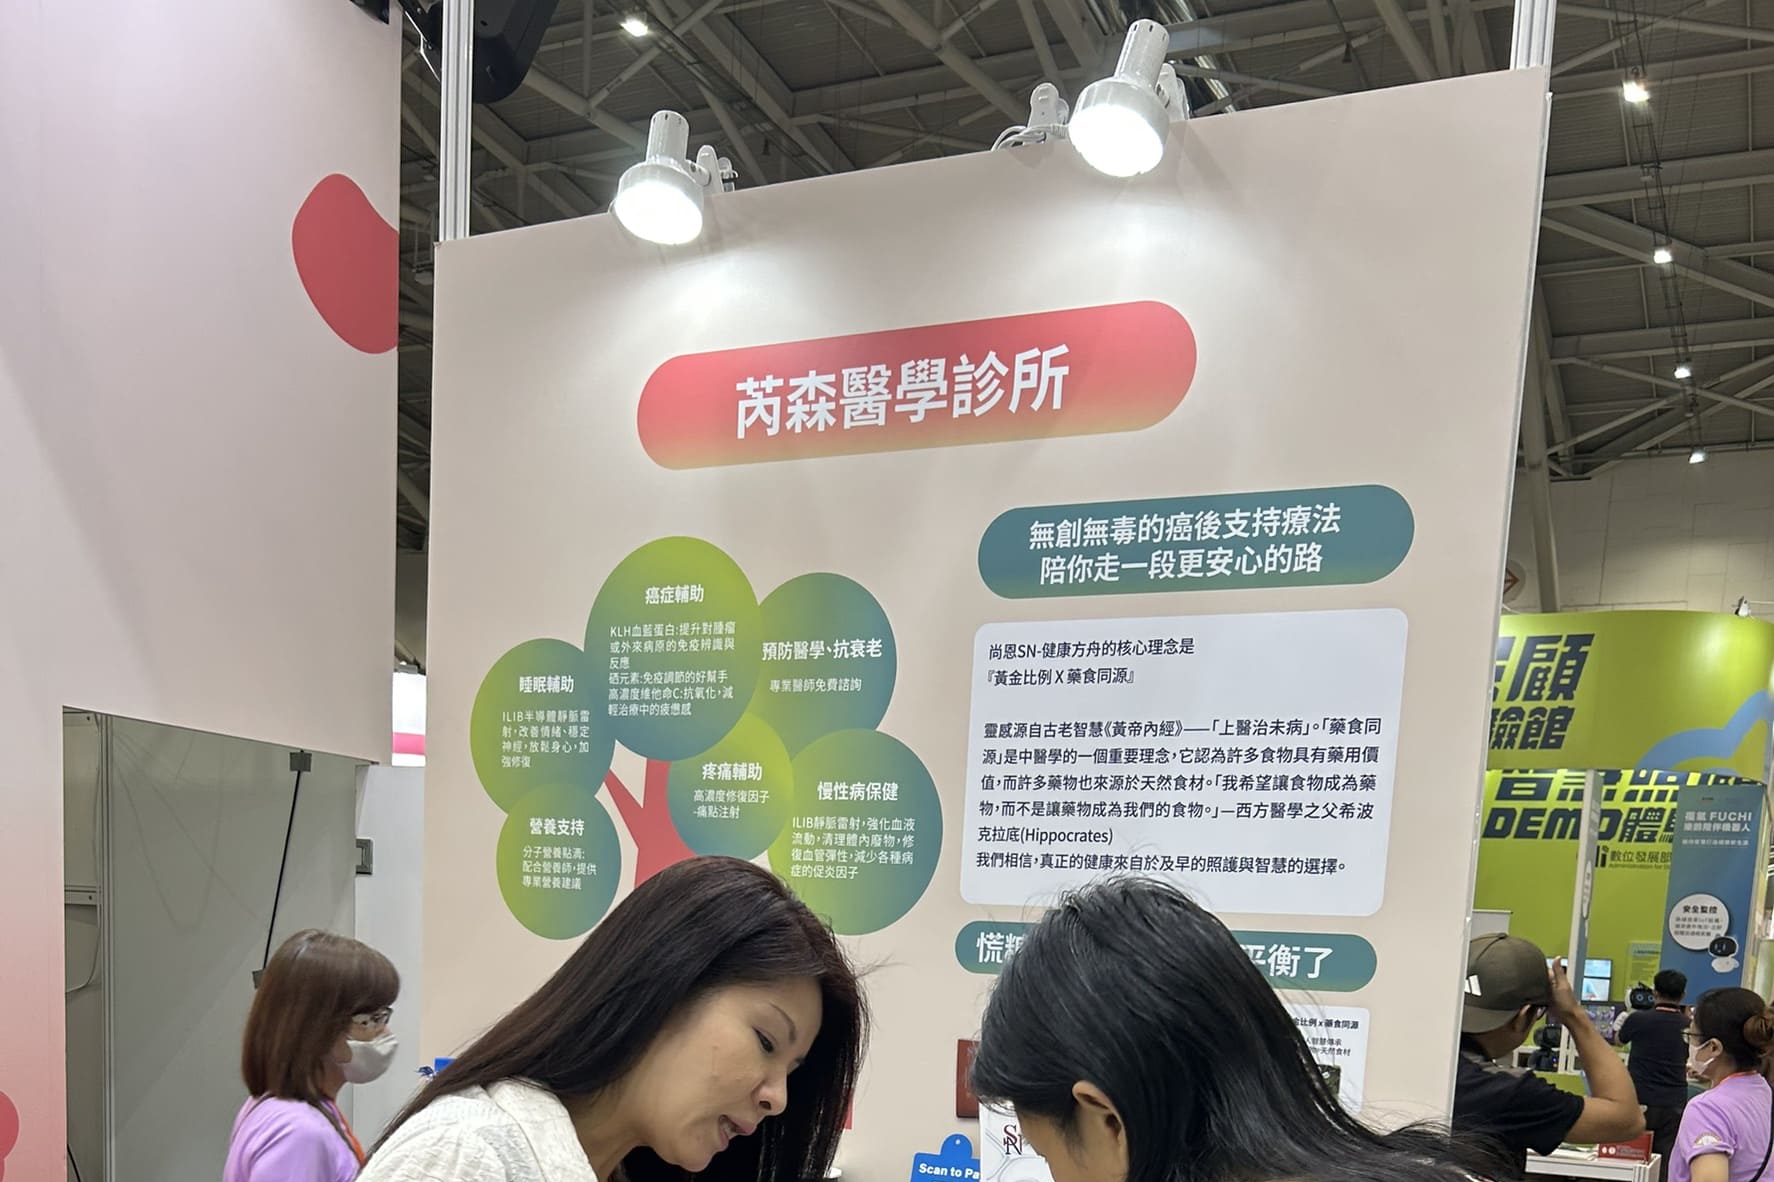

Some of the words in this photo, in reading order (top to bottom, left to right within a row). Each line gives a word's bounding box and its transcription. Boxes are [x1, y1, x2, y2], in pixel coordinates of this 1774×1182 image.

[736, 343, 1071, 439] 芮森醫學診所
[1029, 502, 1342, 551] 無創無毒的癌後支持療法
[1039, 542, 1324, 586] 陪你走一段更安心的路
[645, 584, 705, 604] 癌症輔助
[762, 638, 883, 661] 預防醫學、抗衰老
[988, 637, 1195, 660] 尚恩SN-健康方舟的核心理念是
[609, 656, 630, 670] 反應
[519, 675, 575, 693] 睡眠輔助
[769, 677, 862, 693] 專業醫師免費諮詢
[987, 668, 1052, 686] 『黃金比例
[1067, 667, 1136, 685] 藥食同源』
[501, 755, 531, 768] 強修復
[702, 761, 763, 781] 疼痛輔助
[694, 789, 770, 804] 高濃度修復因子
[818, 781, 900, 801] 慢性病保健
[1709, 811, 1752, 822] FUCHI
[530, 818, 585, 836] 營養支持
[978, 826, 1114, 846] 克拉底(Hippocrates)
[791, 864, 859, 879] 症的促炎因子
[522, 875, 582, 890] 專業營養建議
[919, 1163, 948, 1176] Scan
[950, 1166, 962, 1177] to
[964, 1168, 981, 1182] Pa
